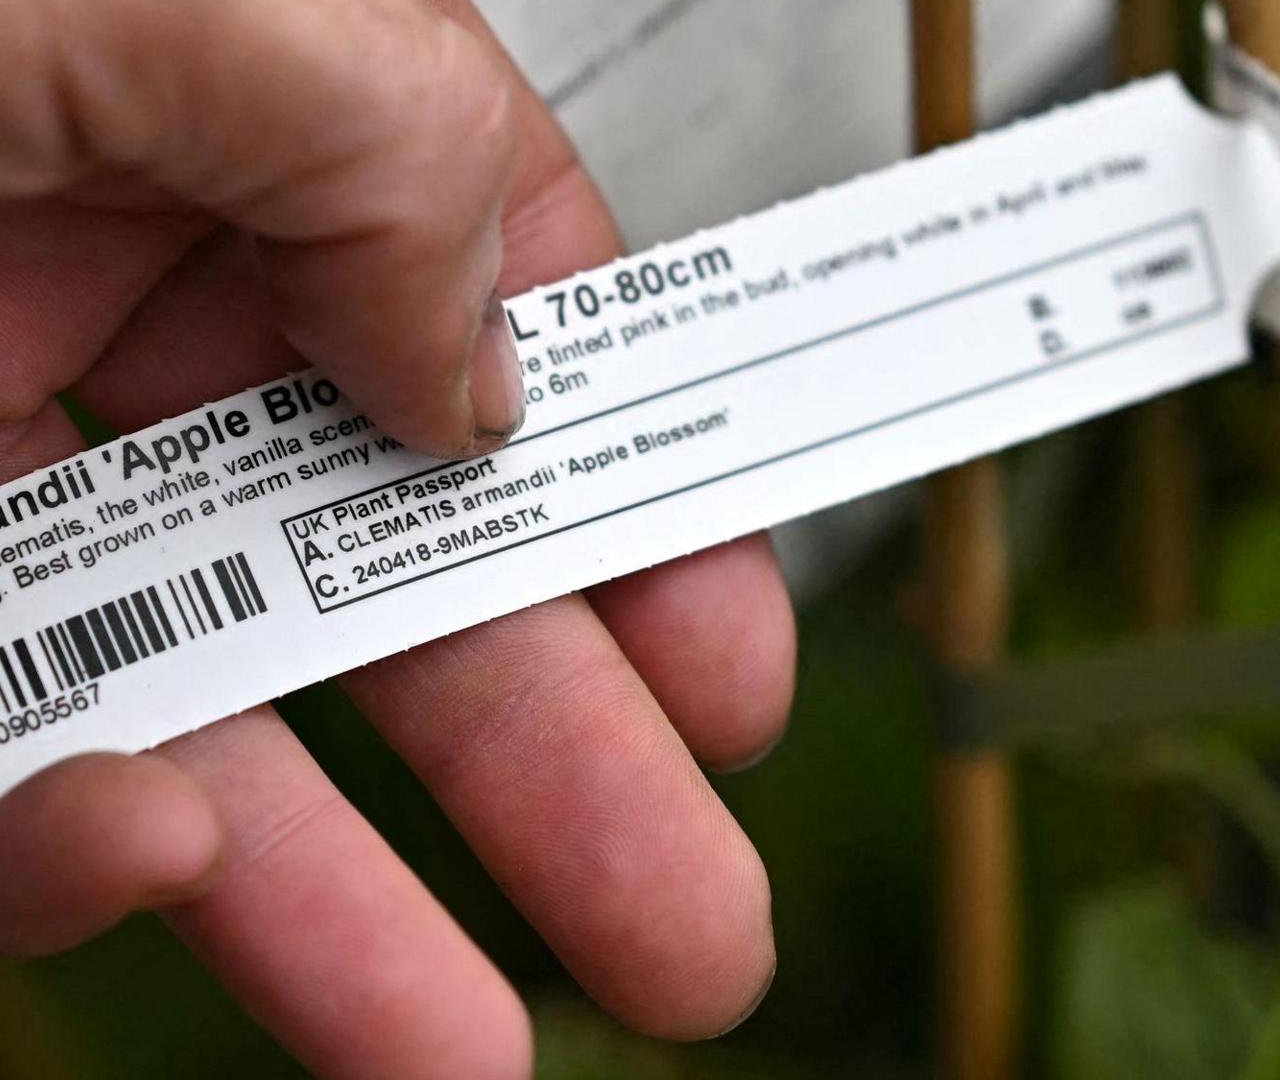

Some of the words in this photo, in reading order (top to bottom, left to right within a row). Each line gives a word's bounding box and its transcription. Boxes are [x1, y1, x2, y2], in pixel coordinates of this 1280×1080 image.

[96, 496, 139, 526] the
[144, 468, 221, 507] white,
[223, 435, 303, 477] vanilla
[309, 414, 376, 446] scen
[547, 330, 614, 367] tinted
[619, 312, 671, 348] pink
[674, 301, 696, 324] in
[701, 289, 739, 317] the
[102, 408, 250, 480] 'Apple
[260, 378, 339, 425] Blo
[545, 245, 733, 328] 70-80cm
[13, 553, 74, 589] Best
[78, 521, 156, 568] grown
[162, 506, 194, 532] on
[199, 497, 217, 516] a
[222, 468, 293, 508] warm
[297, 442, 370, 481] sunny
[548, 371, 589, 395] 6m
[292, 511, 331, 541] UK
[334, 492, 394, 526] Plant
[399, 457, 498, 507] Passport
[302, 540, 334, 567] A.
[336, 500, 457, 554] CLEMATIS
[460, 467, 557, 512] armandii
[559, 439, 630, 478] 'Apple
[634, 407, 729, 457] Blossom'
[313, 573, 350, 600] C.
[352, 504, 550, 586] 240418-9MABSTK
